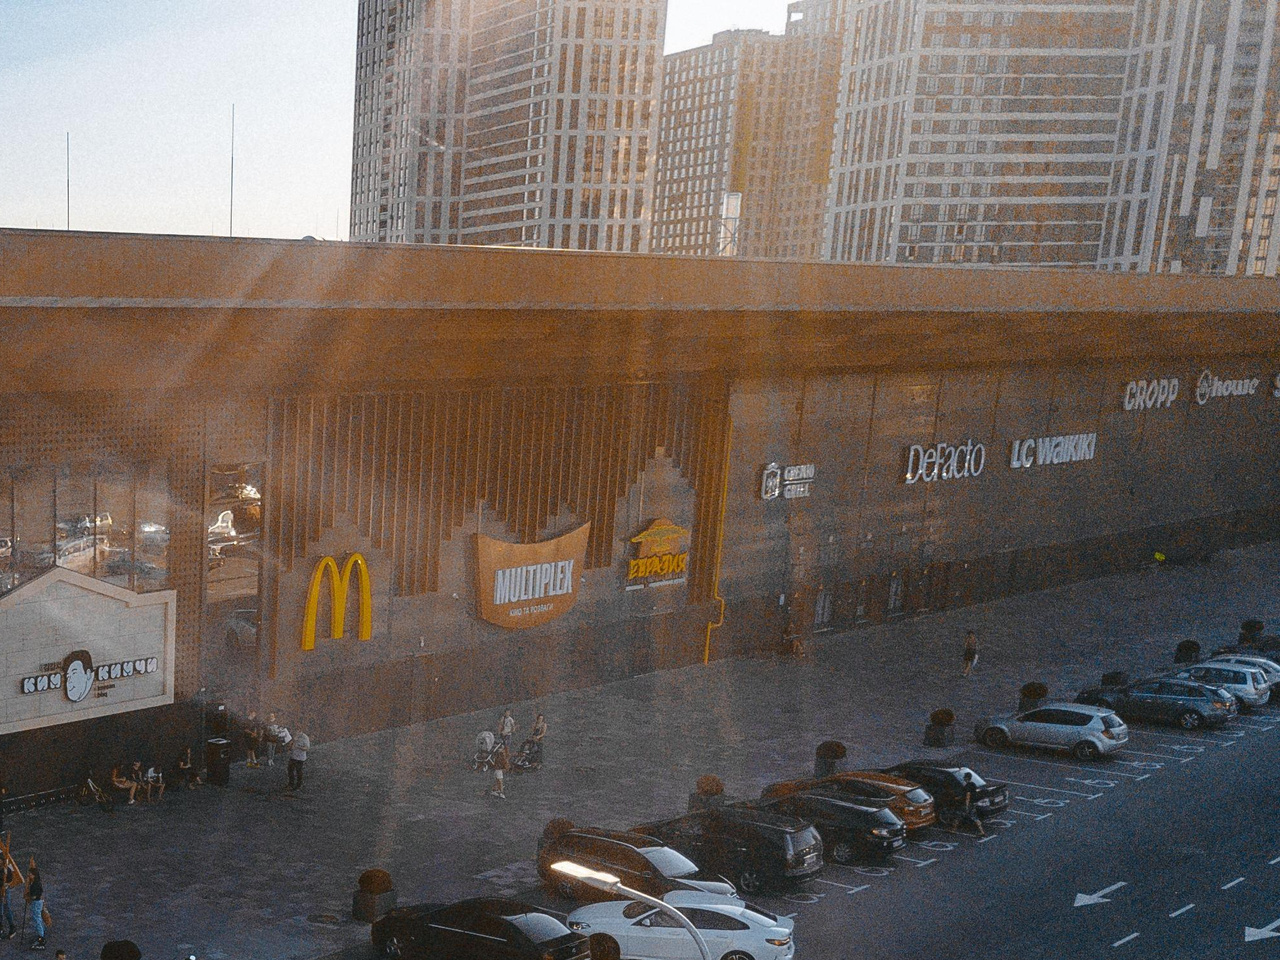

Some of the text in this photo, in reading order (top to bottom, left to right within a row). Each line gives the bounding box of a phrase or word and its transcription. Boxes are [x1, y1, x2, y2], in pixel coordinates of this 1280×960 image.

[1124, 378, 1179, 411] CROPP
[905, 440, 985, 484] DeFacto
[1010, 438, 1035, 468] LC
[494, 559, 574, 605] MULTIPLEX
[22, 656, 158, 694] КИМ КИМЧИ
